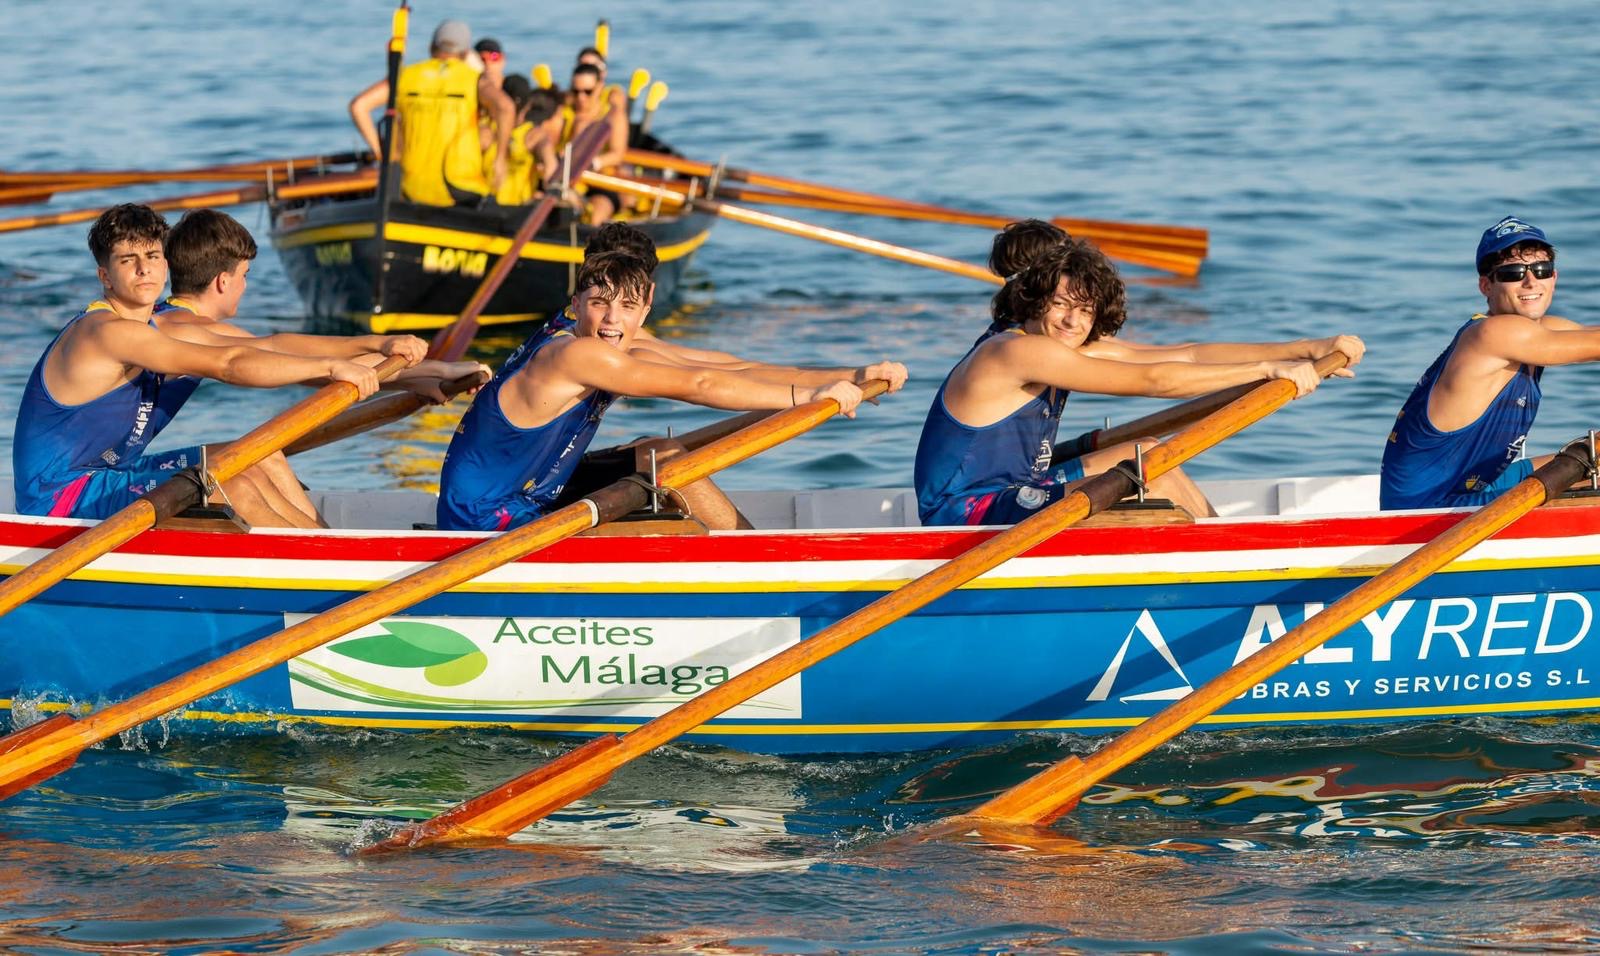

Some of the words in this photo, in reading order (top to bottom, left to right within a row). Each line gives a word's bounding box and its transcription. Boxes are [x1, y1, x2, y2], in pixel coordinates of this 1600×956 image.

[493, 617, 654, 646] Aceites
[1232, 592, 1593, 666] ALYRED
[541, 653, 730, 695] Málaga
[1234, 680, 1331, 700] BRAS
[1344, 679, 1361, 696] Y
[1374, 671, 1532, 695] SERVICIOS
[1546, 668, 1591, 687] S.L
